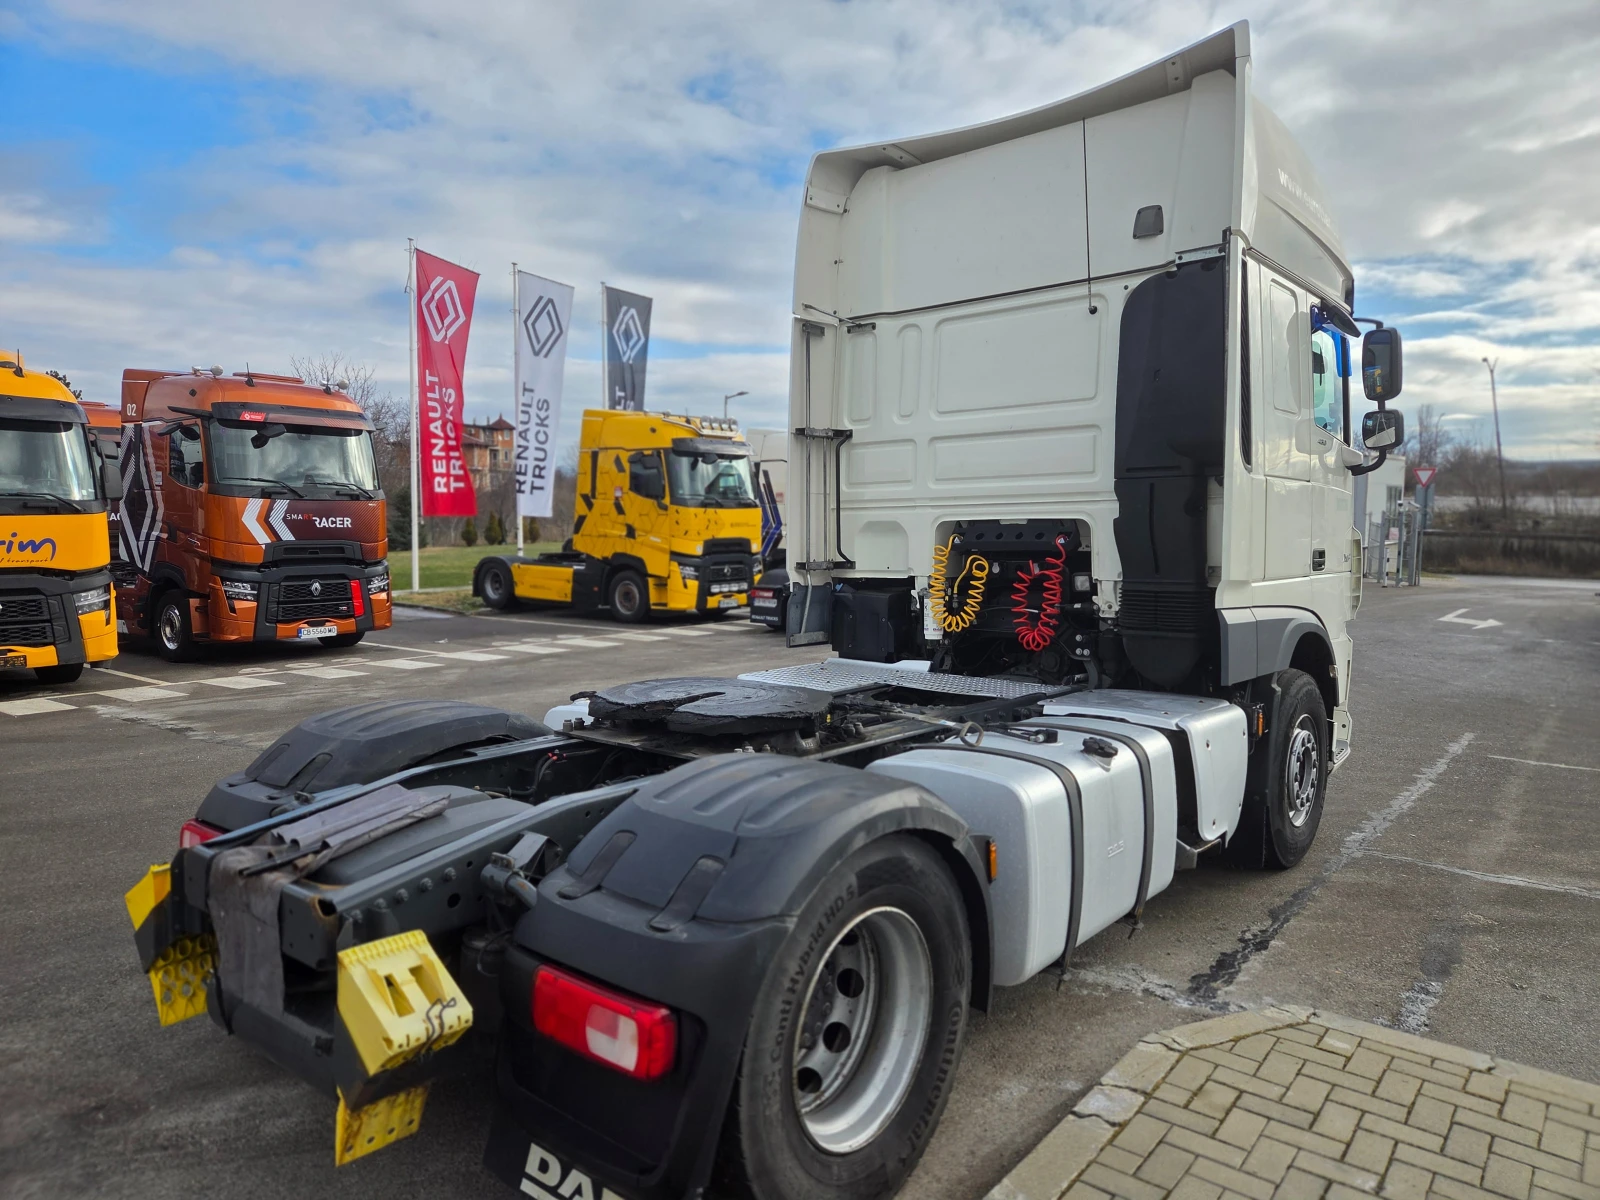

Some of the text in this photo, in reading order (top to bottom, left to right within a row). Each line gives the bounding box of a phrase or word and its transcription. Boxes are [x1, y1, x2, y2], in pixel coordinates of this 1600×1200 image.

[126, 403, 137, 416] 02
[425, 370, 448, 493] RENAULT
[515, 381, 535, 494] RENAULT
[530, 398, 550, 495] TRUCKS
[312, 517, 352, 528] RACER
[787, 921, 826, 995] Hybrid
[906, 1002, 963, 1151] Continental
[525, 1142, 626, 1200] DA
